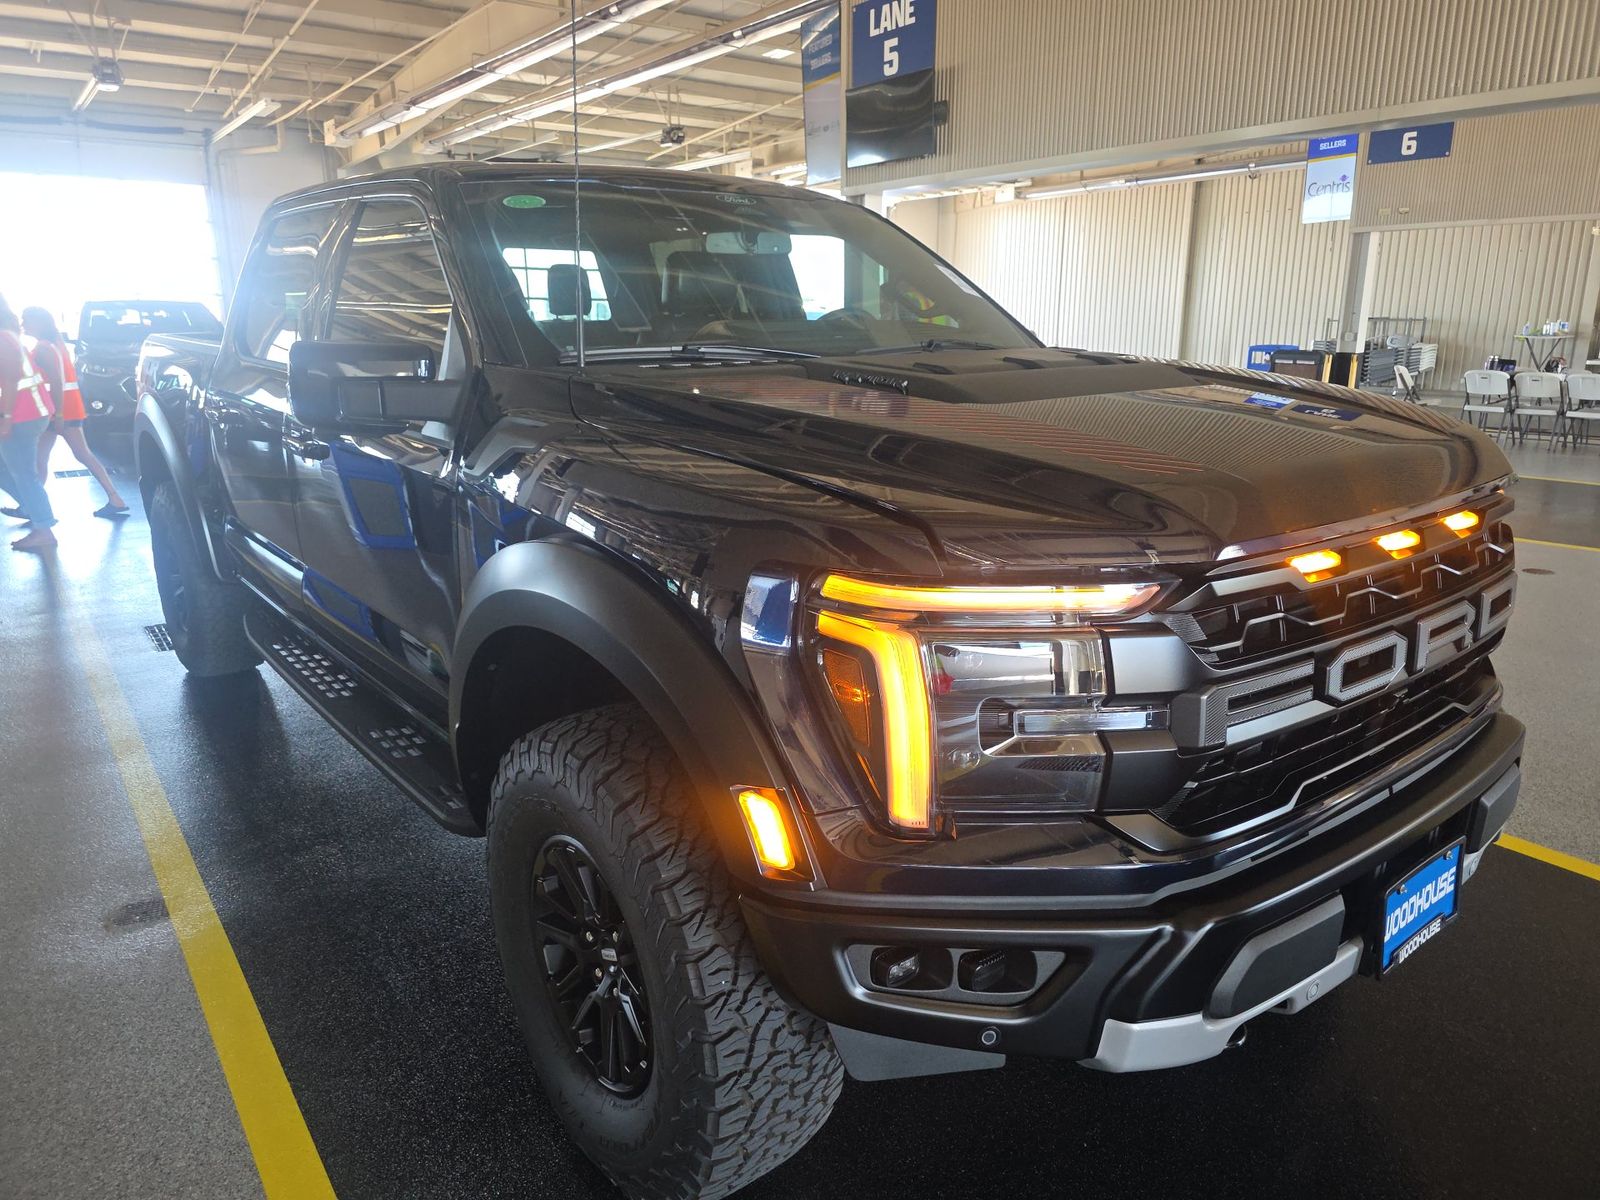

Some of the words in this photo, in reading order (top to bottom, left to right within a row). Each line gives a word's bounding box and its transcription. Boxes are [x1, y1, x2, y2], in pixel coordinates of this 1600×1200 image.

[869, 0, 916, 37] LANE
[883, 37, 899, 77] 5
[1319, 139, 1346, 150] SELLERS
[1401, 131, 1418, 156] 6
[1308, 178, 1350, 198] Centris
[1203, 571, 1517, 746] FORD
[1399, 918, 1441, 964] WOODHOUSE
